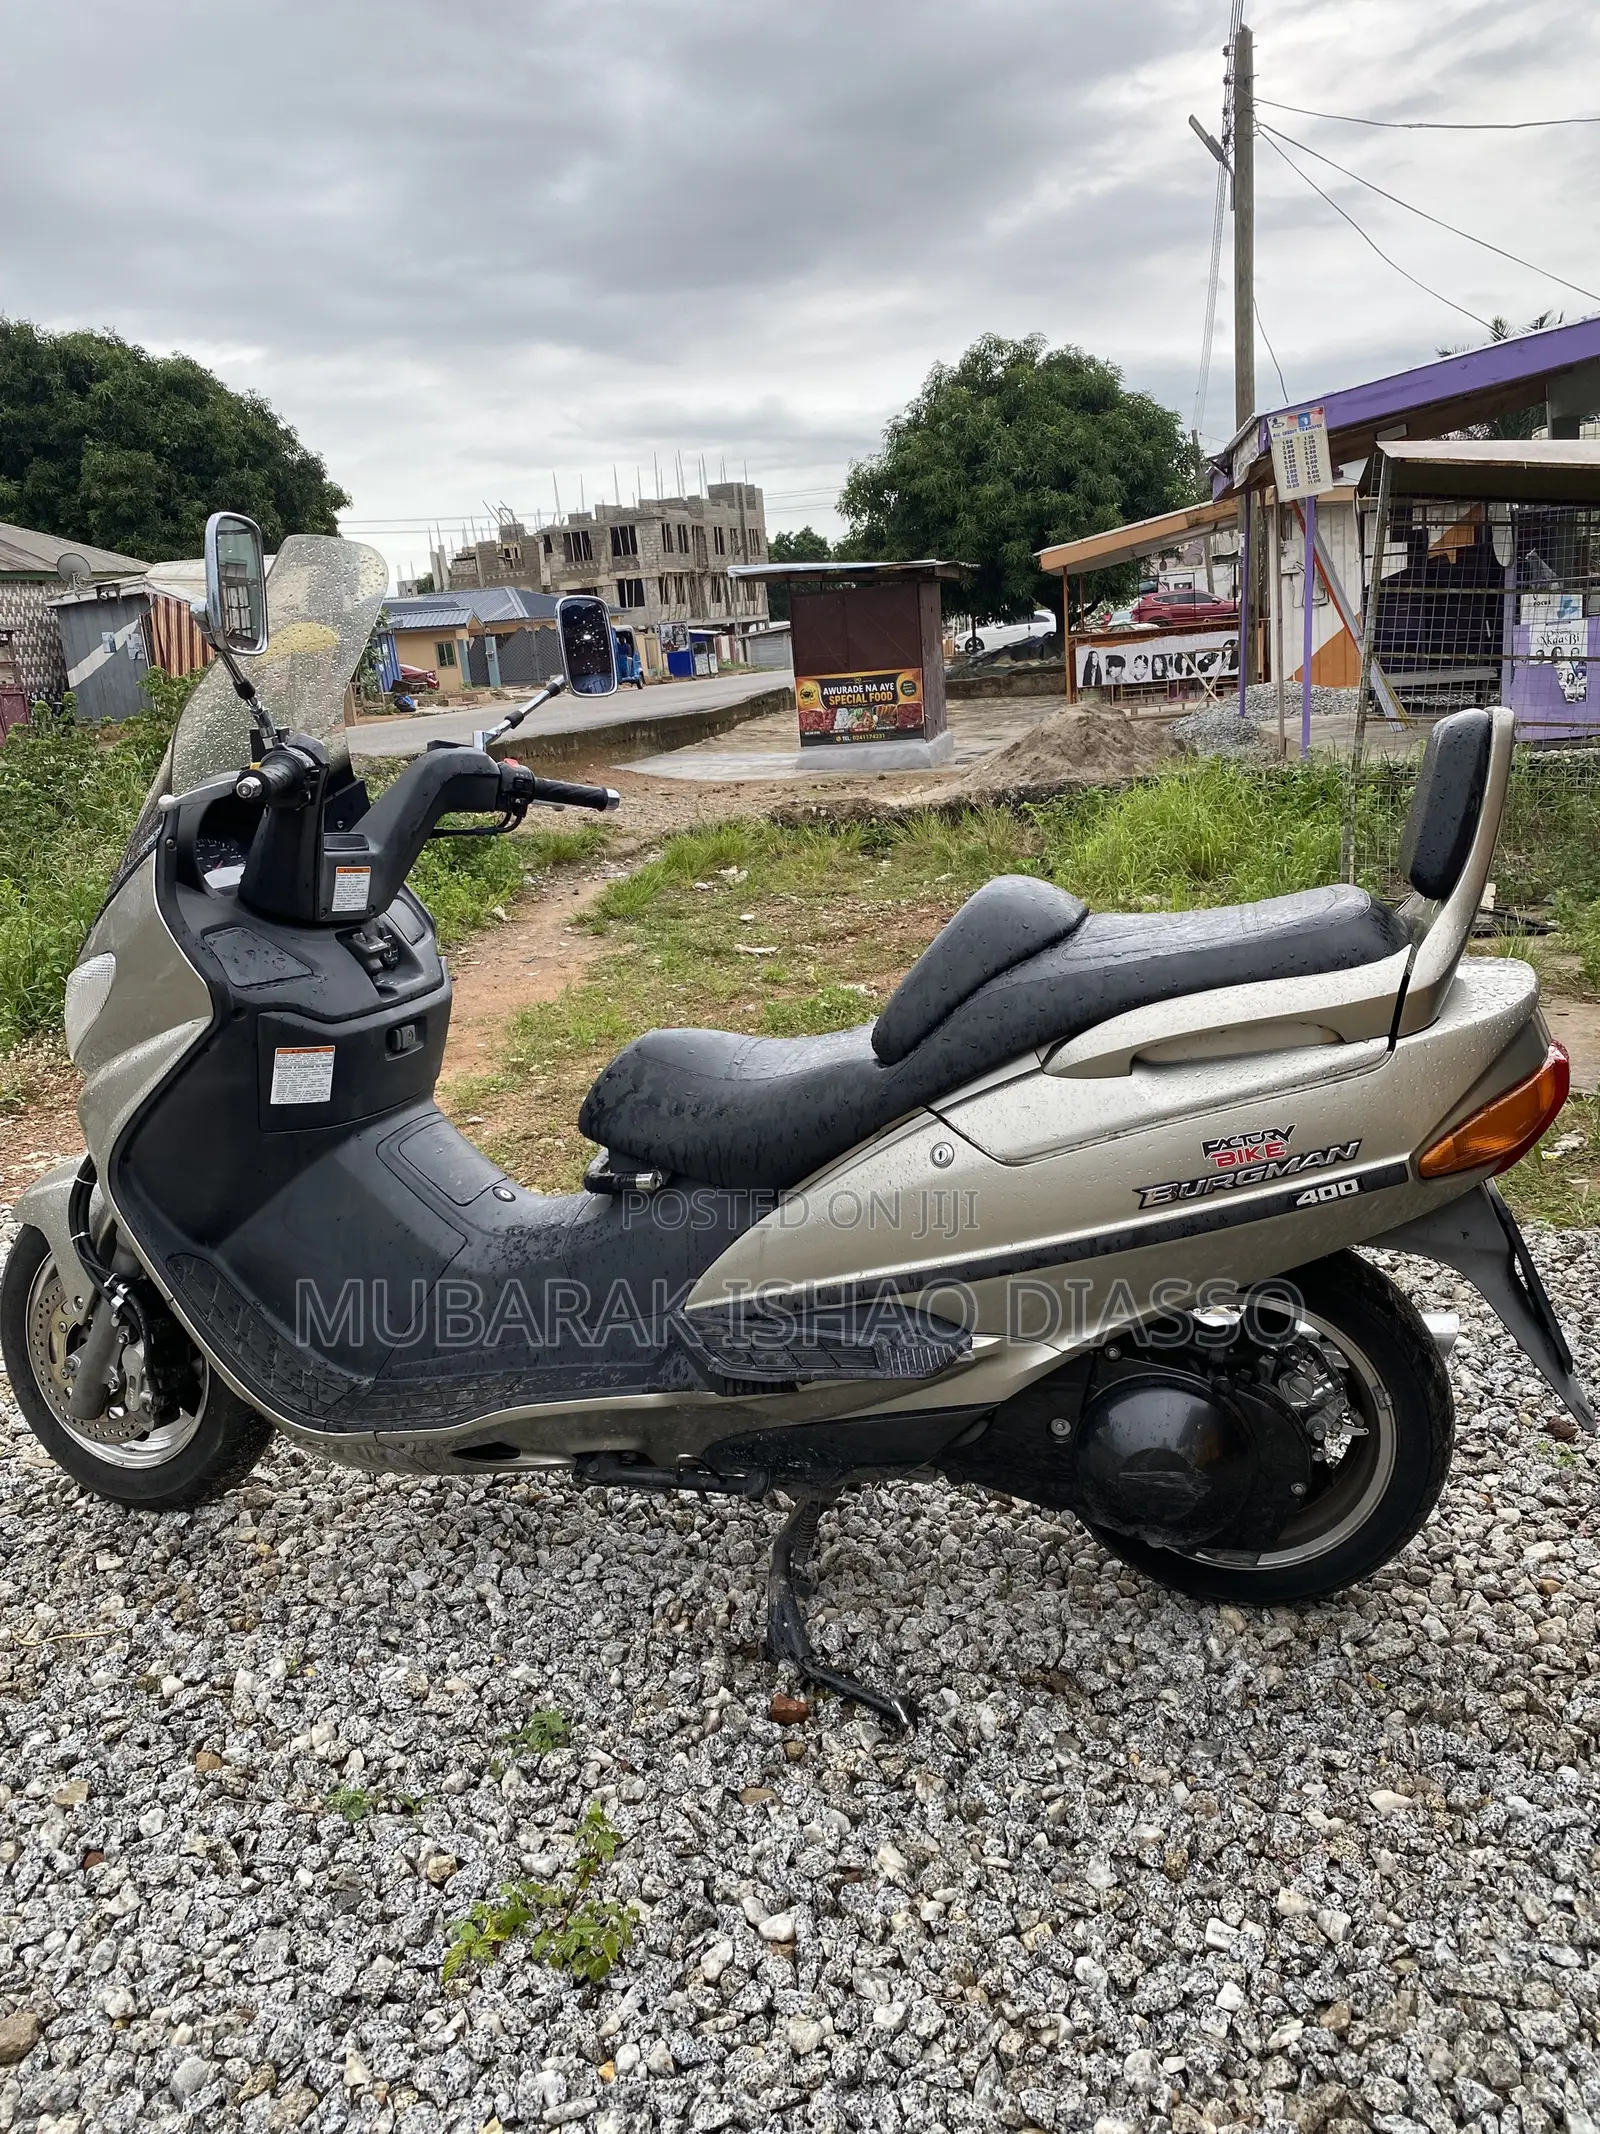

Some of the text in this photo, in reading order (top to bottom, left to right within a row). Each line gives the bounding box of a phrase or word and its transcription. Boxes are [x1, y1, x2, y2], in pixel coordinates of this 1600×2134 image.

[1299, 424, 1322, 432] TRANSFER
[823, 684, 863, 696] AWURADE
[865, 684, 878, 693] NA
[829, 691, 893, 706] SPECIAL FOOD
[1201, 1124, 1296, 1159] FACTORY
[1210, 1141, 1287, 1168] BIKE
[1133, 1138, 1362, 1209] BURGMAN
[1296, 1178, 1361, 1206] 400
